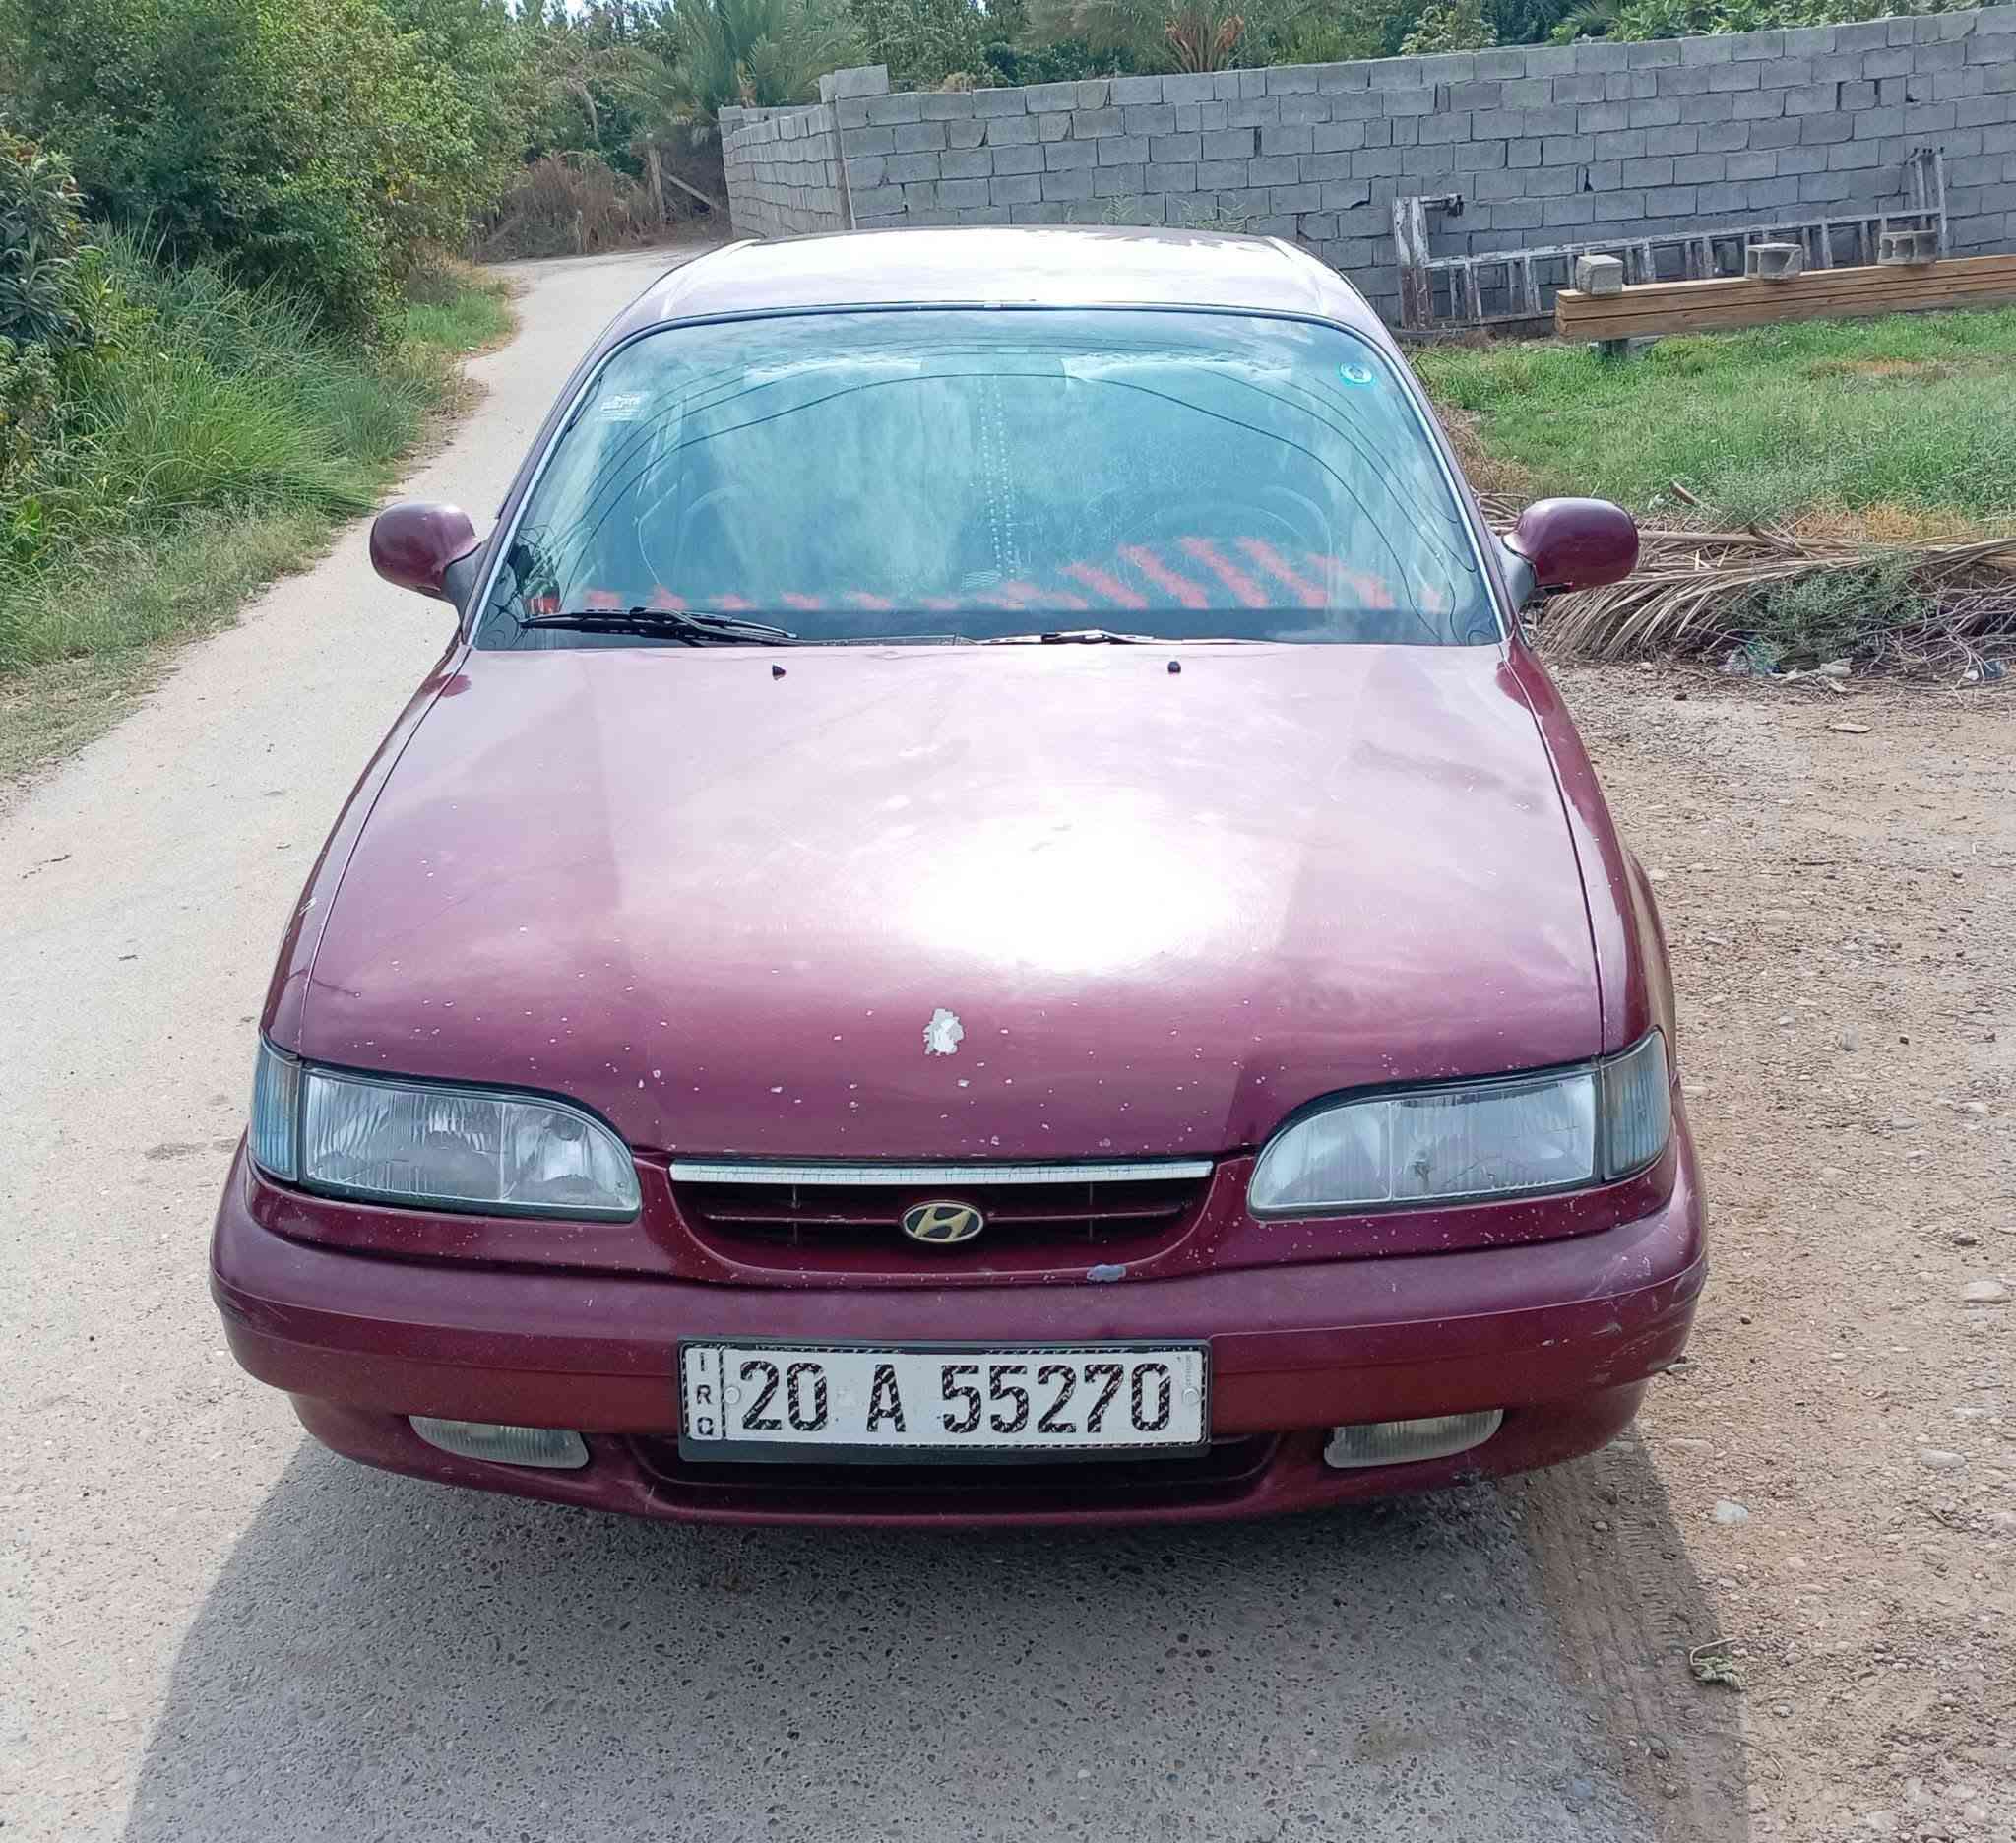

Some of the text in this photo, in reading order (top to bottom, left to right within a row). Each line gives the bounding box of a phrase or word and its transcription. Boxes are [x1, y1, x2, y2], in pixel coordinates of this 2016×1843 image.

[740, 1360, 828, 1431] 20
[866, 1364, 906, 1432] A
[941, 1363, 1171, 1433] 55270
